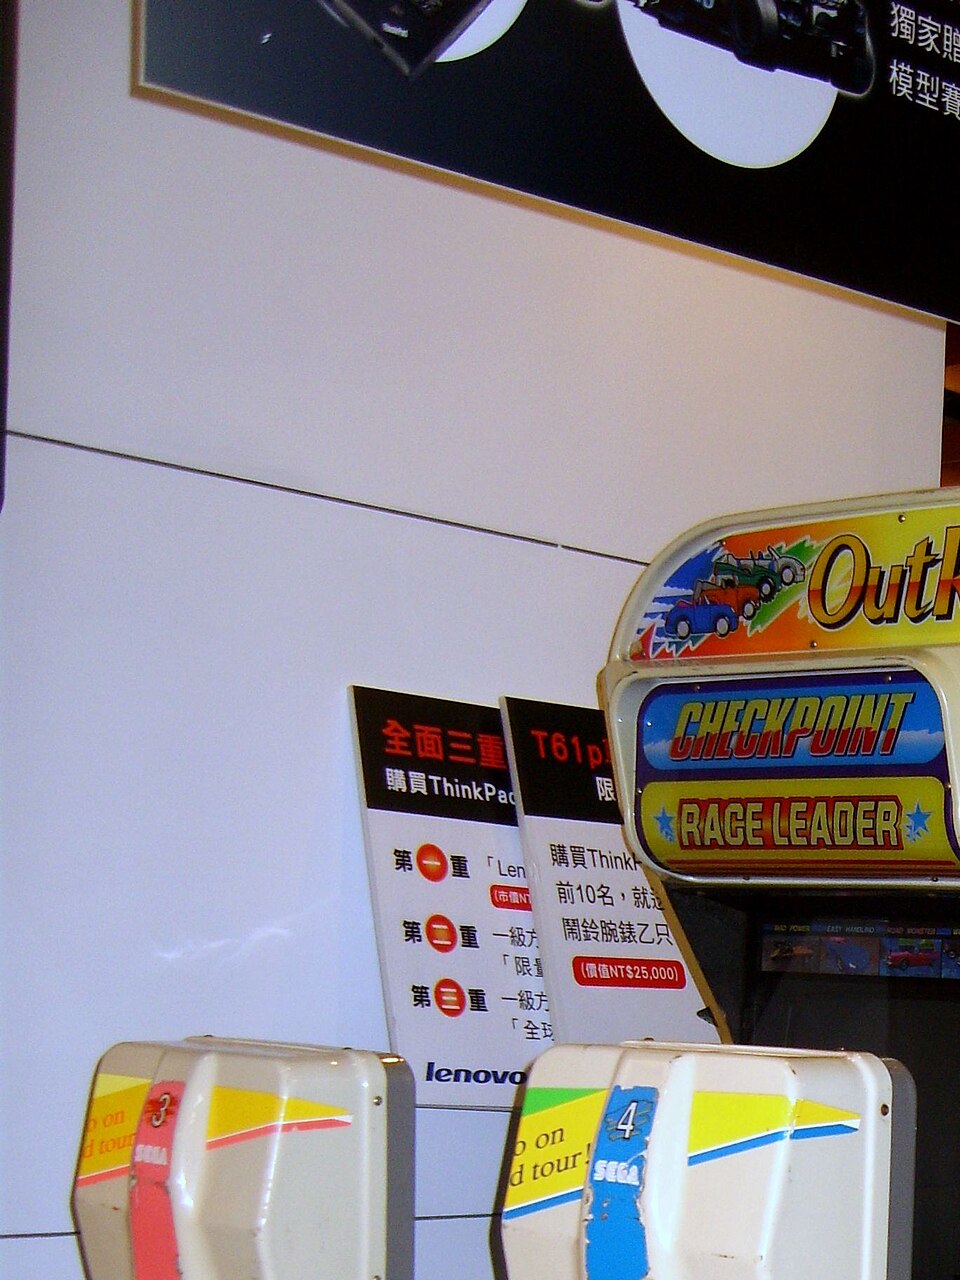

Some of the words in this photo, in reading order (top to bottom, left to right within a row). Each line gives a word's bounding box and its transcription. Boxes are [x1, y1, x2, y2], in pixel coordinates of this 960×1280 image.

[382, 719, 507, 769] 全面三重
[669, 691, 915, 762] CHECKPOINT
[680, 800, 767, 847] RACE
[771, 798, 901, 847] LEADER
[426, 1062, 528, 1085] lenovo
[151, 1092, 171, 1129] 3
[616, 1100, 639, 1140] 4
[535, 1127, 564, 1149] on
[593, 1159, 640, 1186] SEGA
